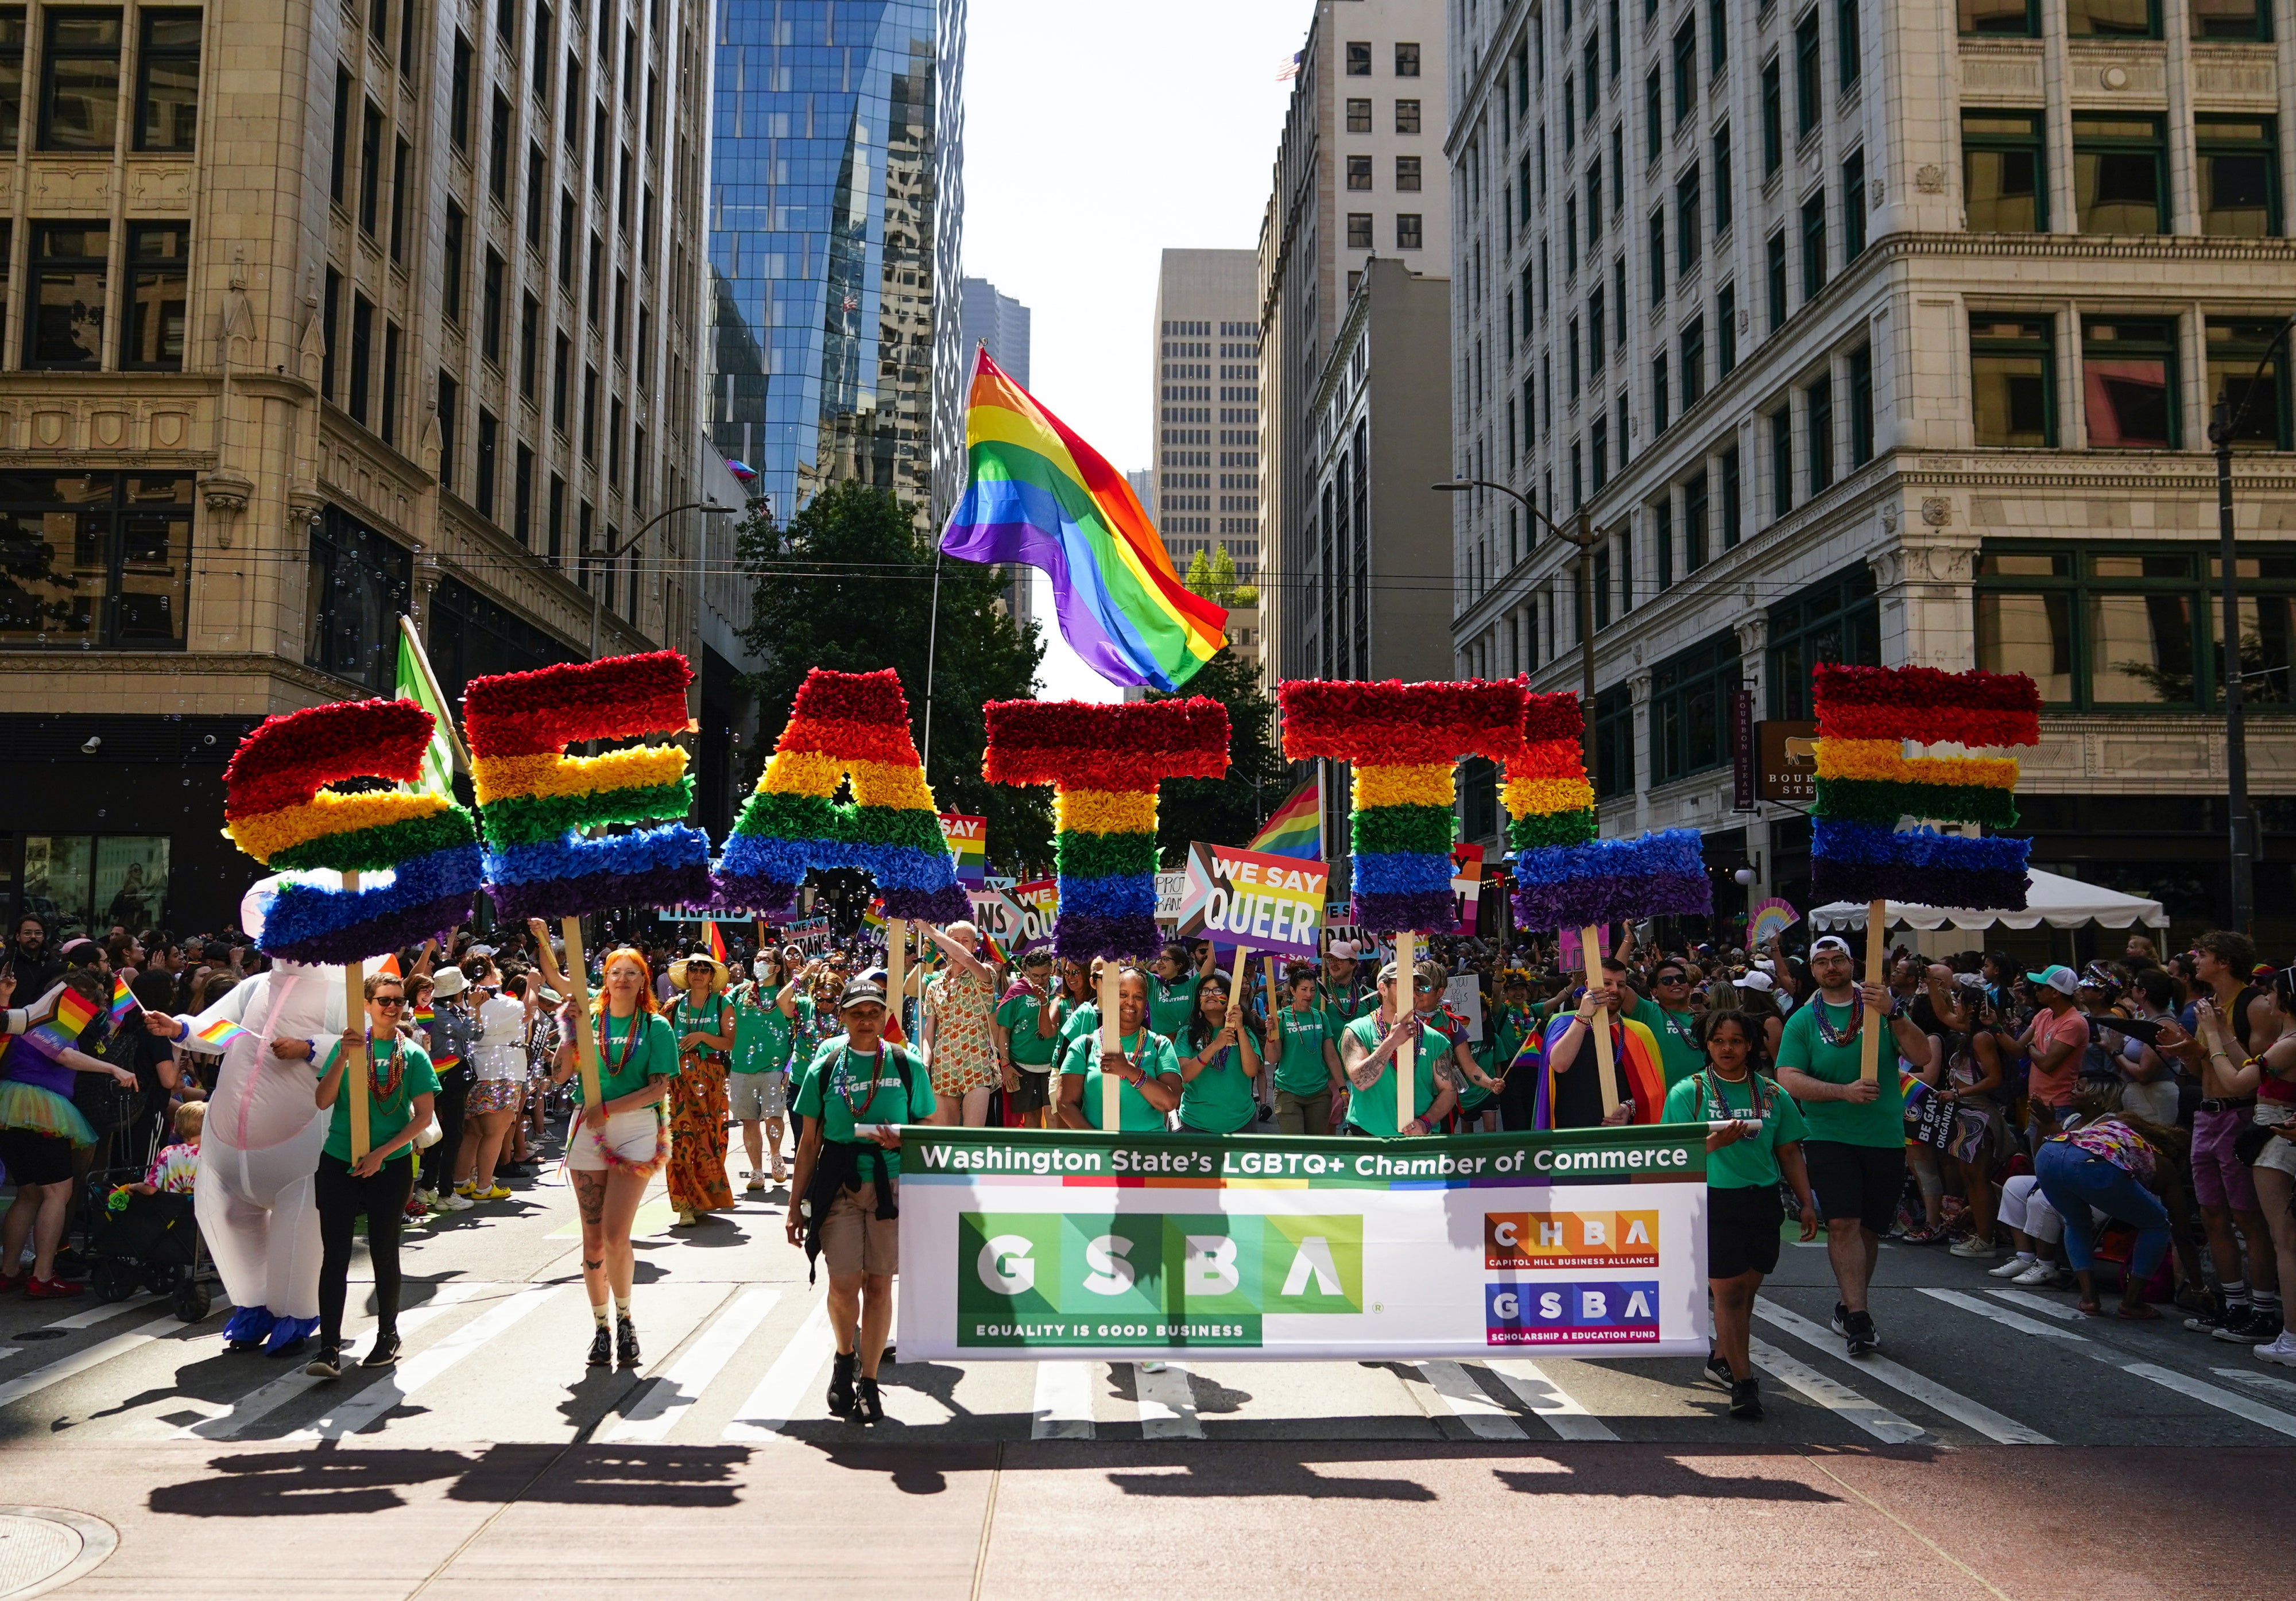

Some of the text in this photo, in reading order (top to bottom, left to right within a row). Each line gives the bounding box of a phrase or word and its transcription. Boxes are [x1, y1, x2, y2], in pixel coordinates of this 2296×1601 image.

[1783, 786, 1814, 794] STE
[940, 819, 979, 838] SAY
[1211, 856, 1323, 893] WE SAY
[1017, 888, 1052, 906] WE
[1204, 887, 1315, 946] QUEER
[793, 922, 807, 933] WE
[1455, 976, 1468, 987] YOU
[1450, 993, 1468, 1002] FEELS
[1918, 1093, 1938, 1142] BE GAY
[1933, 1115, 1941, 1129] AND
[1936, 1101, 1954, 1149] ORGANIZE
[921, 1145, 1688, 1176] Washington State's LGBTQ+ Chamber of Commerce
[1489, 1257, 1655, 1266] CAPITOL HILL BUSINESS ALLIANCE
[977, 1324, 1243, 1337] EQUALITY IS GOOD BUSINESS
[1492, 1331, 1656, 1342] SCHOLARSHIP & EDUCATION FUND
